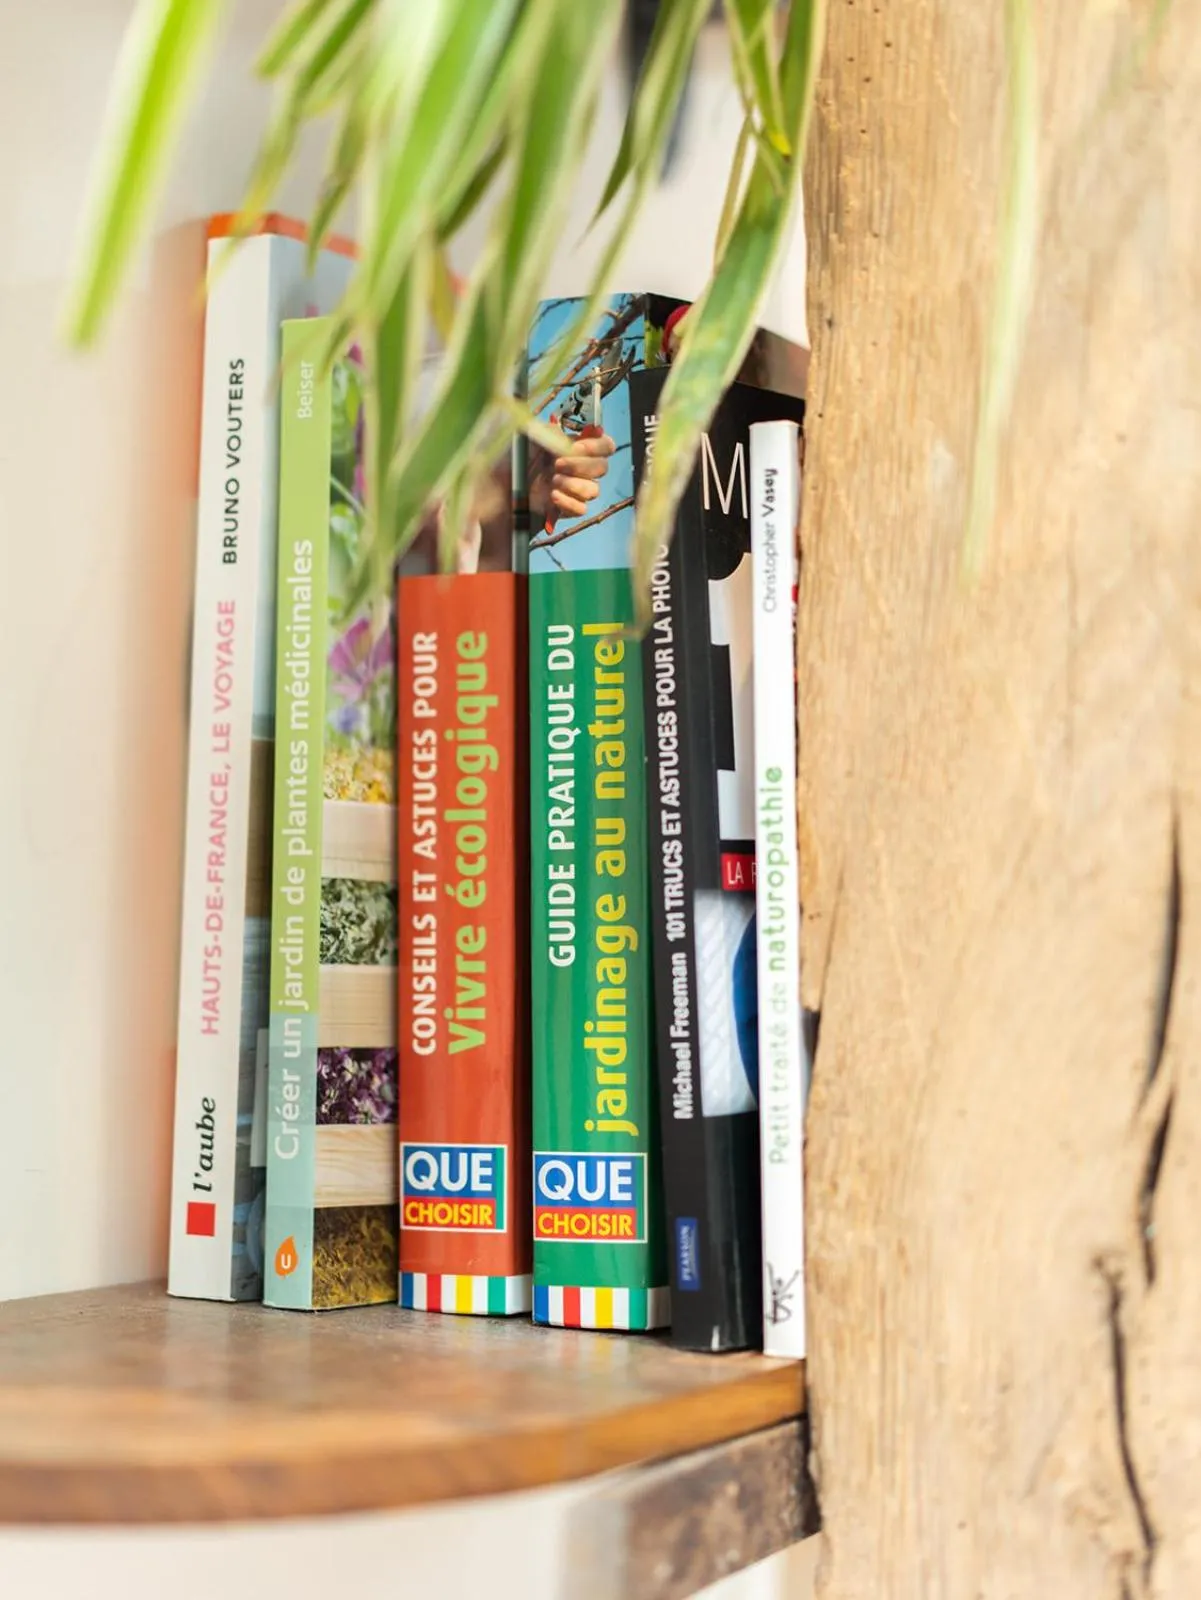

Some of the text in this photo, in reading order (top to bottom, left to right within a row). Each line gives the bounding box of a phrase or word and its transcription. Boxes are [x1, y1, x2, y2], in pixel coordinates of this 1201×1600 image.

[296, 360, 315, 419] Beiser
[222, 357, 245, 565] BRUNO VOUTERS
[761, 467, 780, 613] Christopher Vasey
[653, 616, 673, 644] LA
[654, 647, 677, 707] POUR
[548, 624, 582, 967] GUIDE PRATIQUE DU
[657, 709, 680, 807] ASTUCES
[200, 600, 235, 1036] HAUTS-DE-FRANCE, LE VOYAGE
[274, 539, 313, 1160] Créer un jardin de plantes médicinales
[412, 632, 438, 1056] CONSEILS ET ASTUCES POUR
[443, 630, 499, 1055] Vivre écologique
[661, 810, 682, 836] ET
[582, 622, 639, 1137] jardinage au naturel
[662, 839, 684, 911] TRUCS
[727, 861, 744, 884] LA
[666, 912, 685, 942] 101
[759, 766, 790, 1165] Petit traité de naturopathie
[670, 952, 689, 1036] Freeman
[670, 1042, 693, 1120] Michael
[193, 1096, 217, 1194] l'aube
[405, 1151, 493, 1191] QUE
[538, 1160, 632, 1201] QUE
[404, 1202, 493, 1226] CHOISIR
[538, 1213, 633, 1236] CHOISIR
